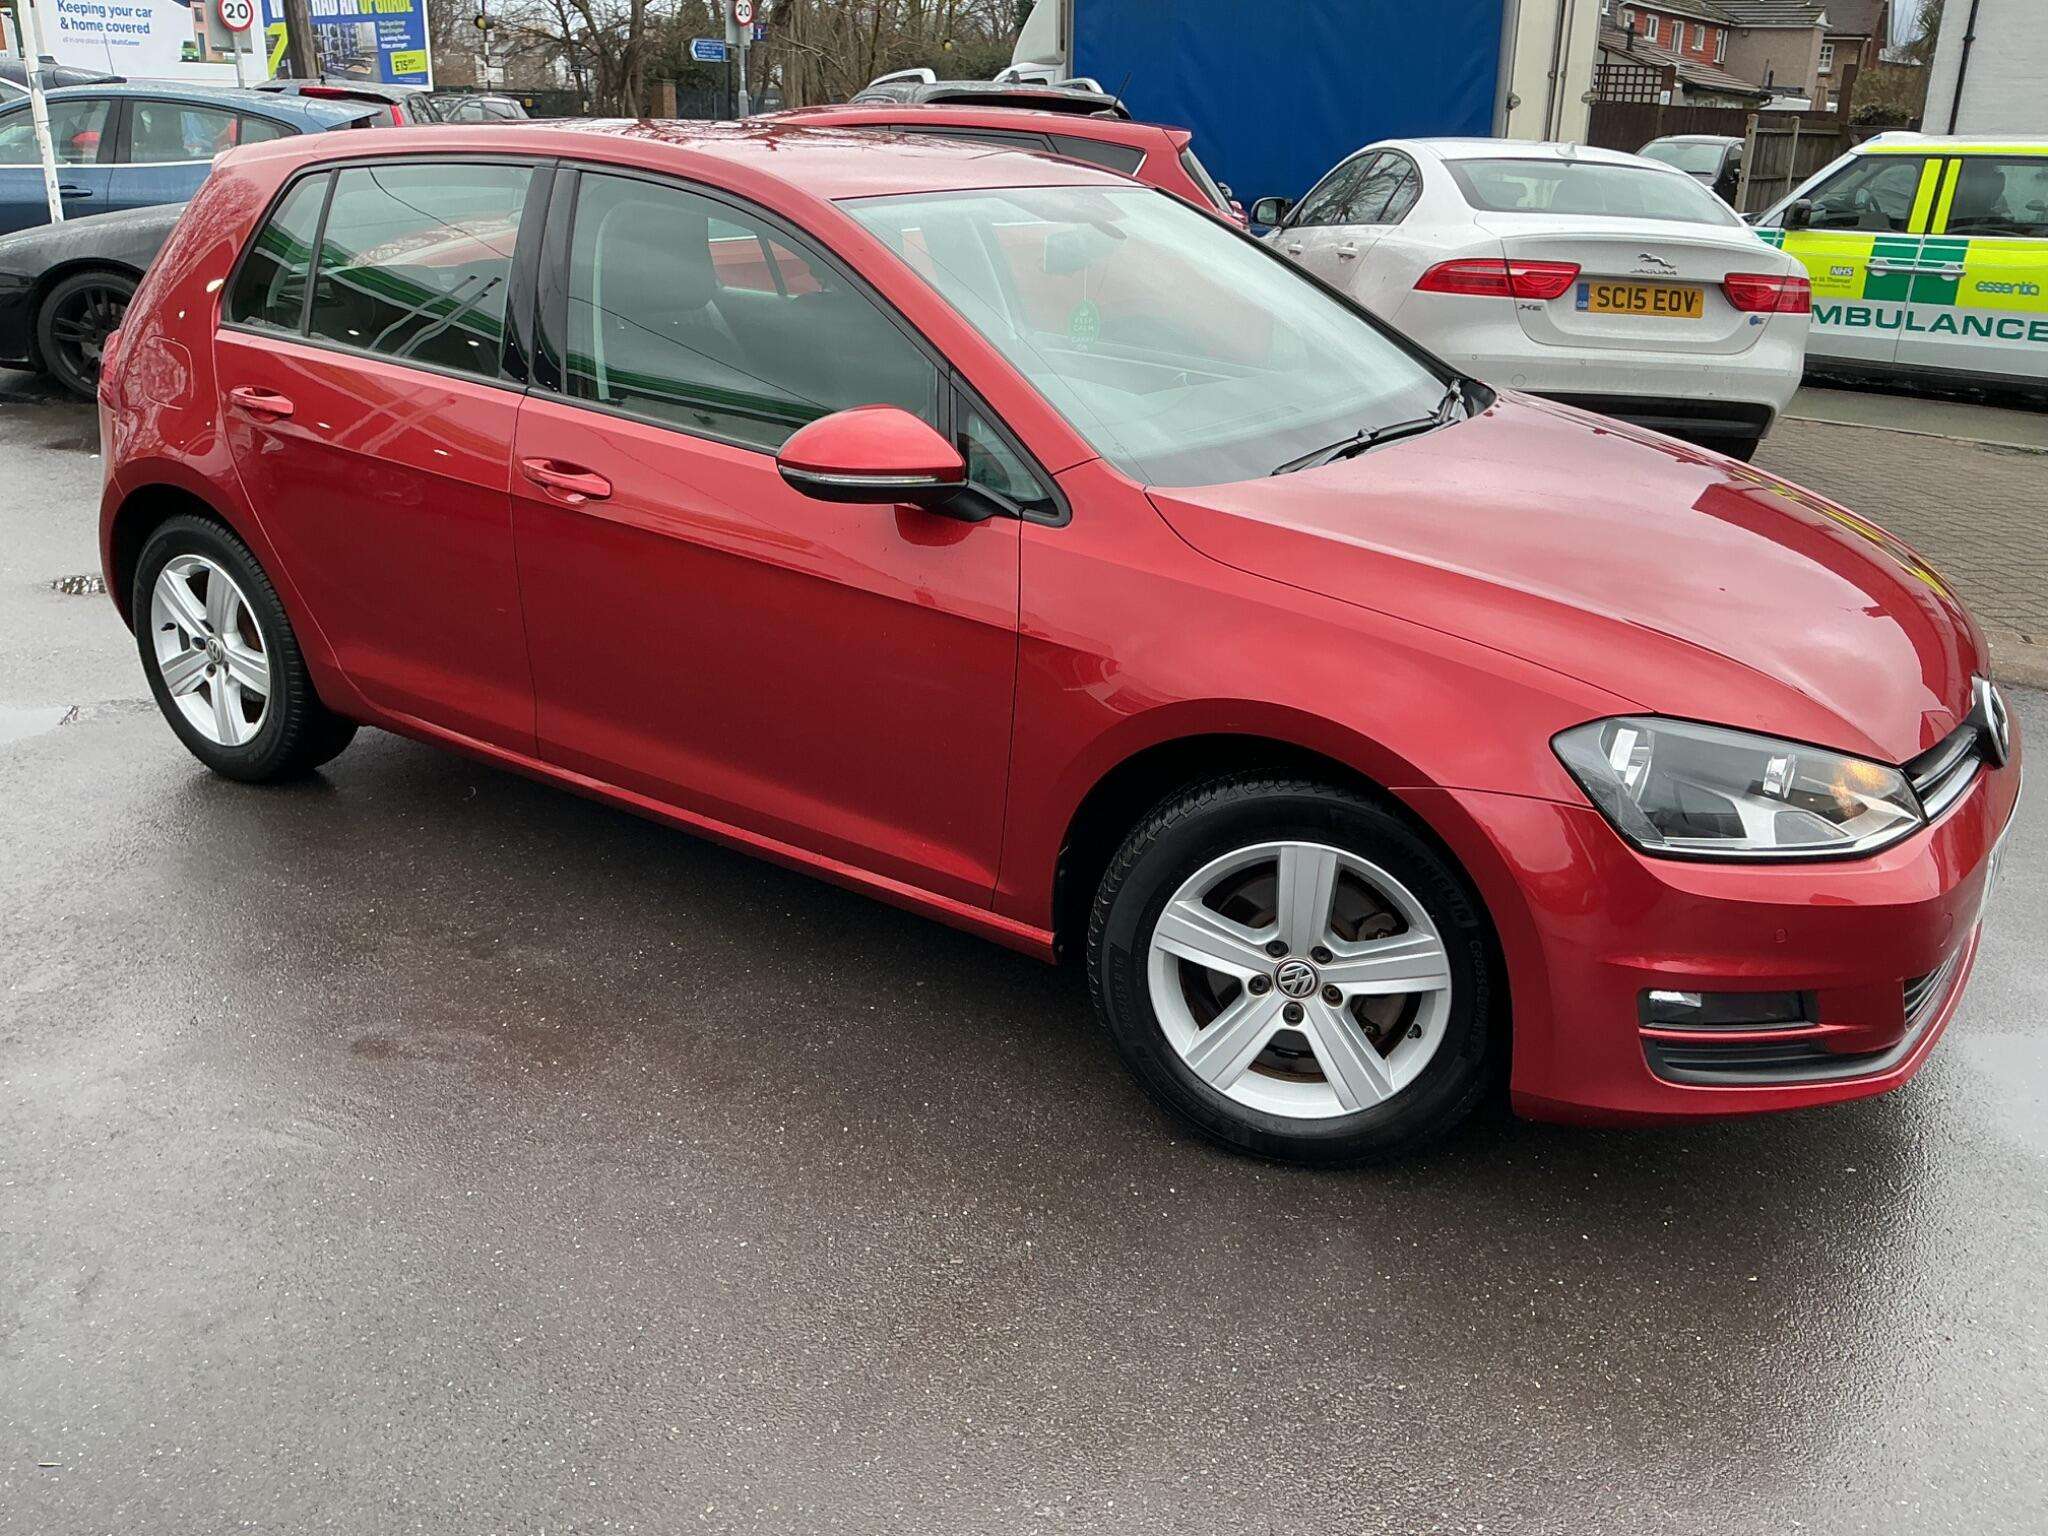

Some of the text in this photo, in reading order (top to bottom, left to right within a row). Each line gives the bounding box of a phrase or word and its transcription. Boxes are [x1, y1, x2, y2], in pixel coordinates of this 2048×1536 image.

[57, 0, 152, 18] Keeping your car
[224, 3, 248, 19] 20
[738, 4, 749, 16] 20
[60, 17, 150, 34] & home covered
[1630, 268, 1677, 276] JAGUAR
[1831, 266, 1853, 276] NHS
[1597, 286, 1696, 313] SC15 EOV
[1811, 303, 2048, 343] MBULANCE
